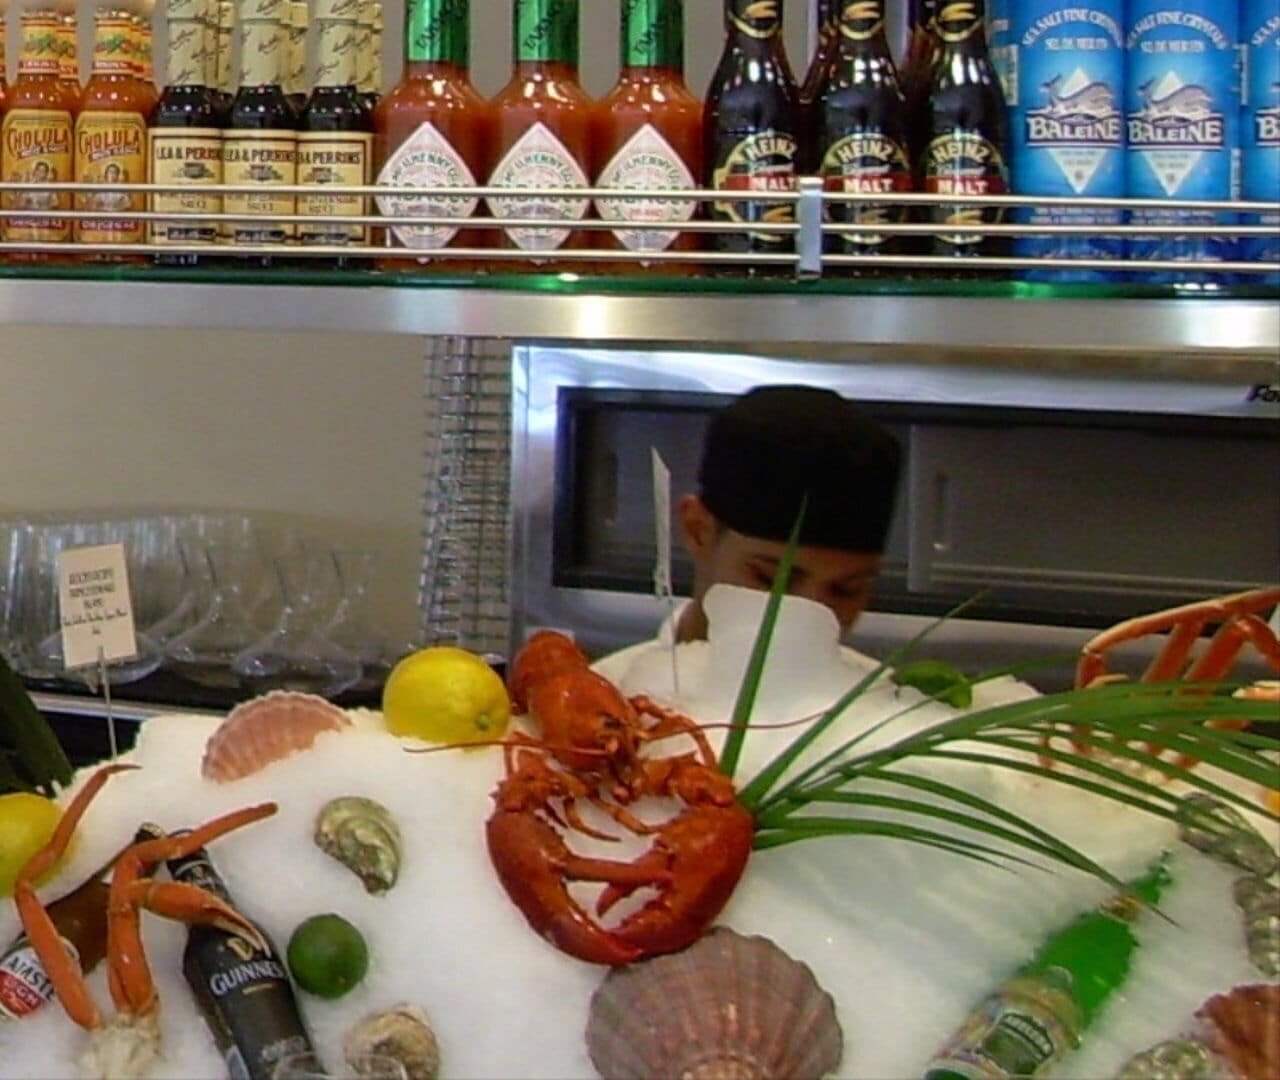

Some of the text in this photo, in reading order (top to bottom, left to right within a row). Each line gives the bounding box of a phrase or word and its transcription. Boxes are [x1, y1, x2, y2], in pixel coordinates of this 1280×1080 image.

[1027, 116, 1121, 142] BALEINE
[1128, 119, 1222, 144] BALEINE
[8, 127, 70, 161] CHOLULA
[79, 128, 141, 162] CHOLULA
[744, 137, 798, 162] HEINZ
[838, 138, 892, 164] HEINZ
[933, 139, 990, 164] HEINZ
[751, 176, 796, 191] MALT
[842, 177, 895, 194] MALT
[936, 178, 989, 195] MALT
